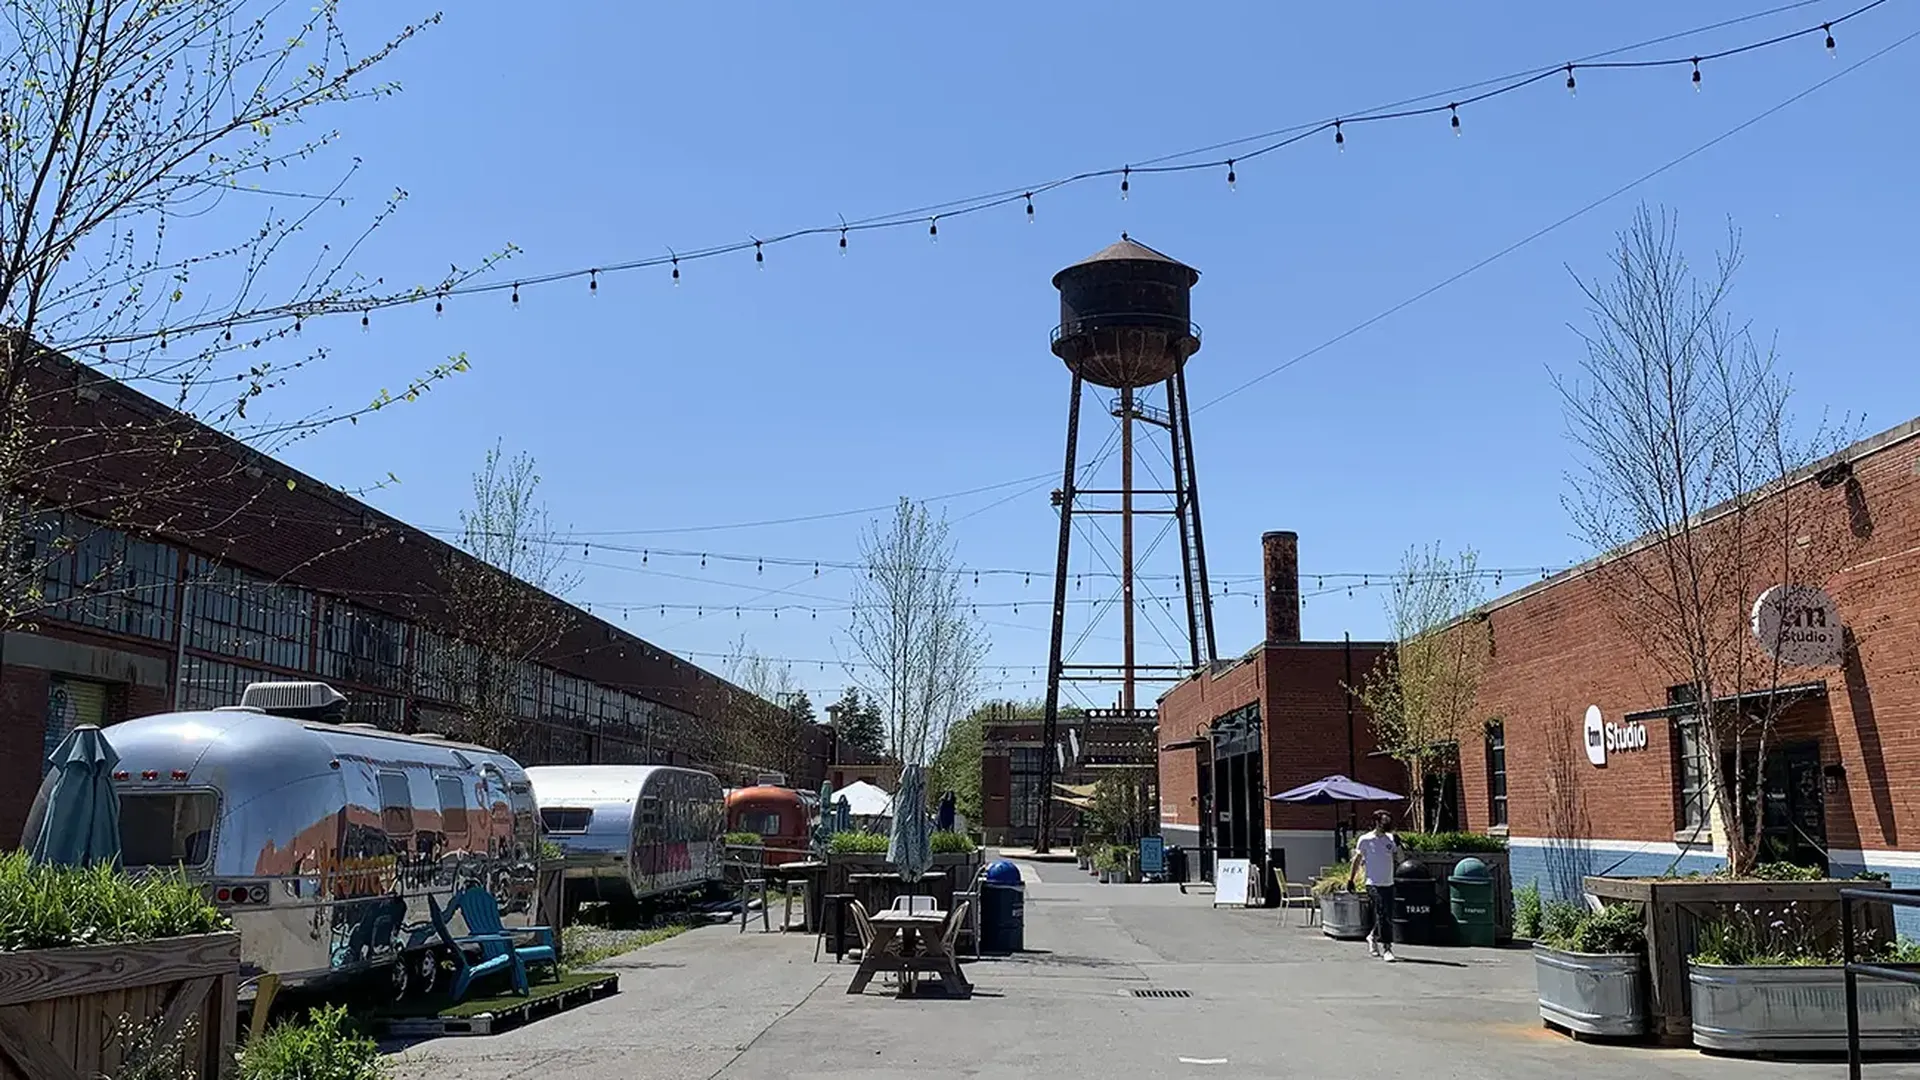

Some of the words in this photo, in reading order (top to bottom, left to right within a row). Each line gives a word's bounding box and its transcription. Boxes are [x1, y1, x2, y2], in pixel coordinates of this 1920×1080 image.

[1782, 631, 1827, 643] Studio
[1588, 726, 1601, 747] tm
[1606, 720, 1647, 751] Studio
[1223, 866, 1244, 874] HEX
[1406, 904, 1431, 914] TRASH
